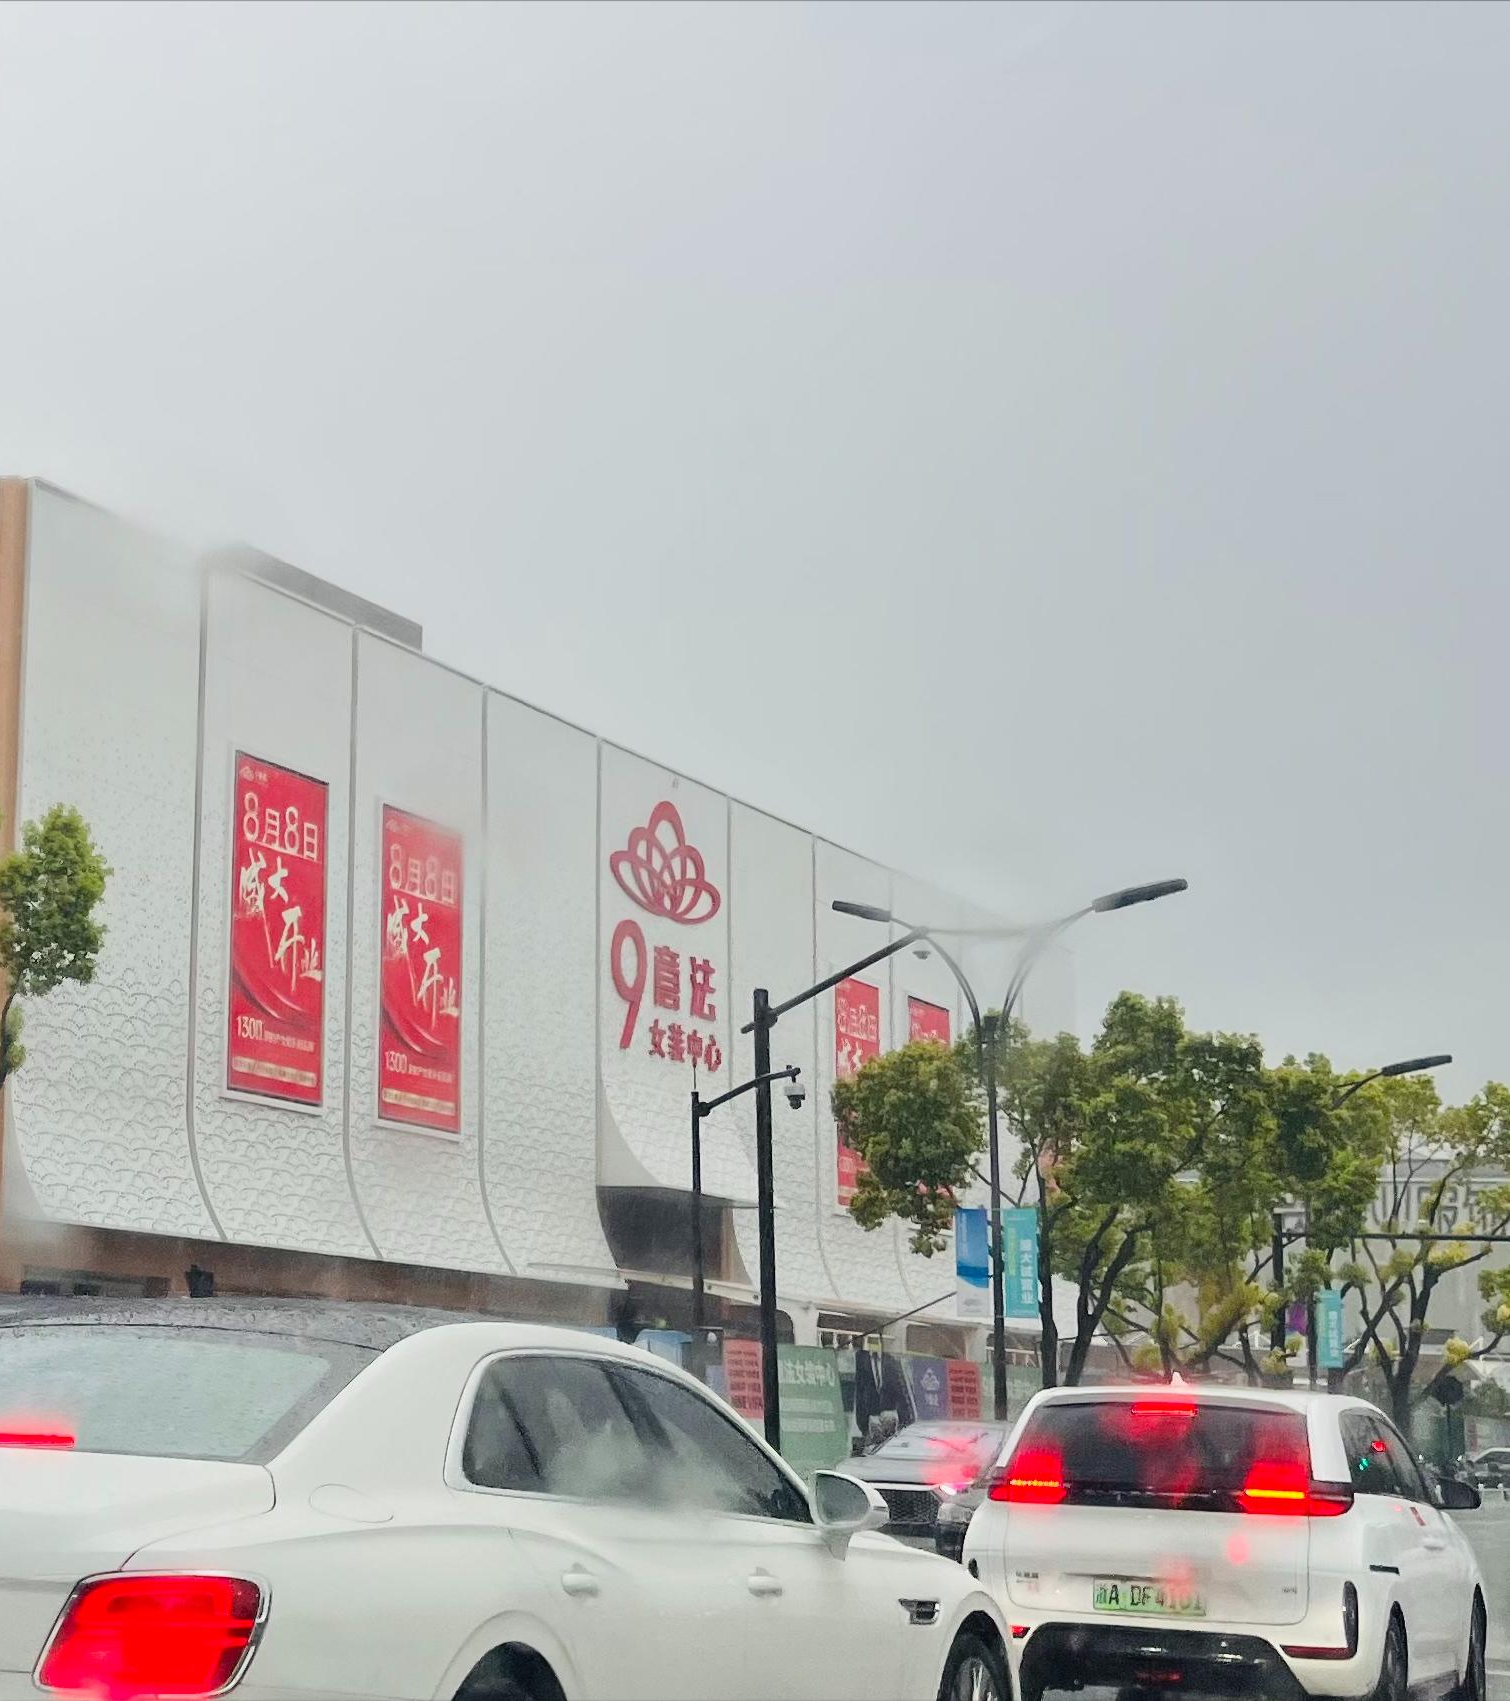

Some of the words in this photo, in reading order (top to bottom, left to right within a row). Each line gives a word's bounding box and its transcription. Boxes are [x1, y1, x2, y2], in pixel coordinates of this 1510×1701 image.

[242, 791, 320, 862] 8月8日
[388, 842, 457, 905] 8月8日
[648, 1018, 723, 1073] 女装中心
